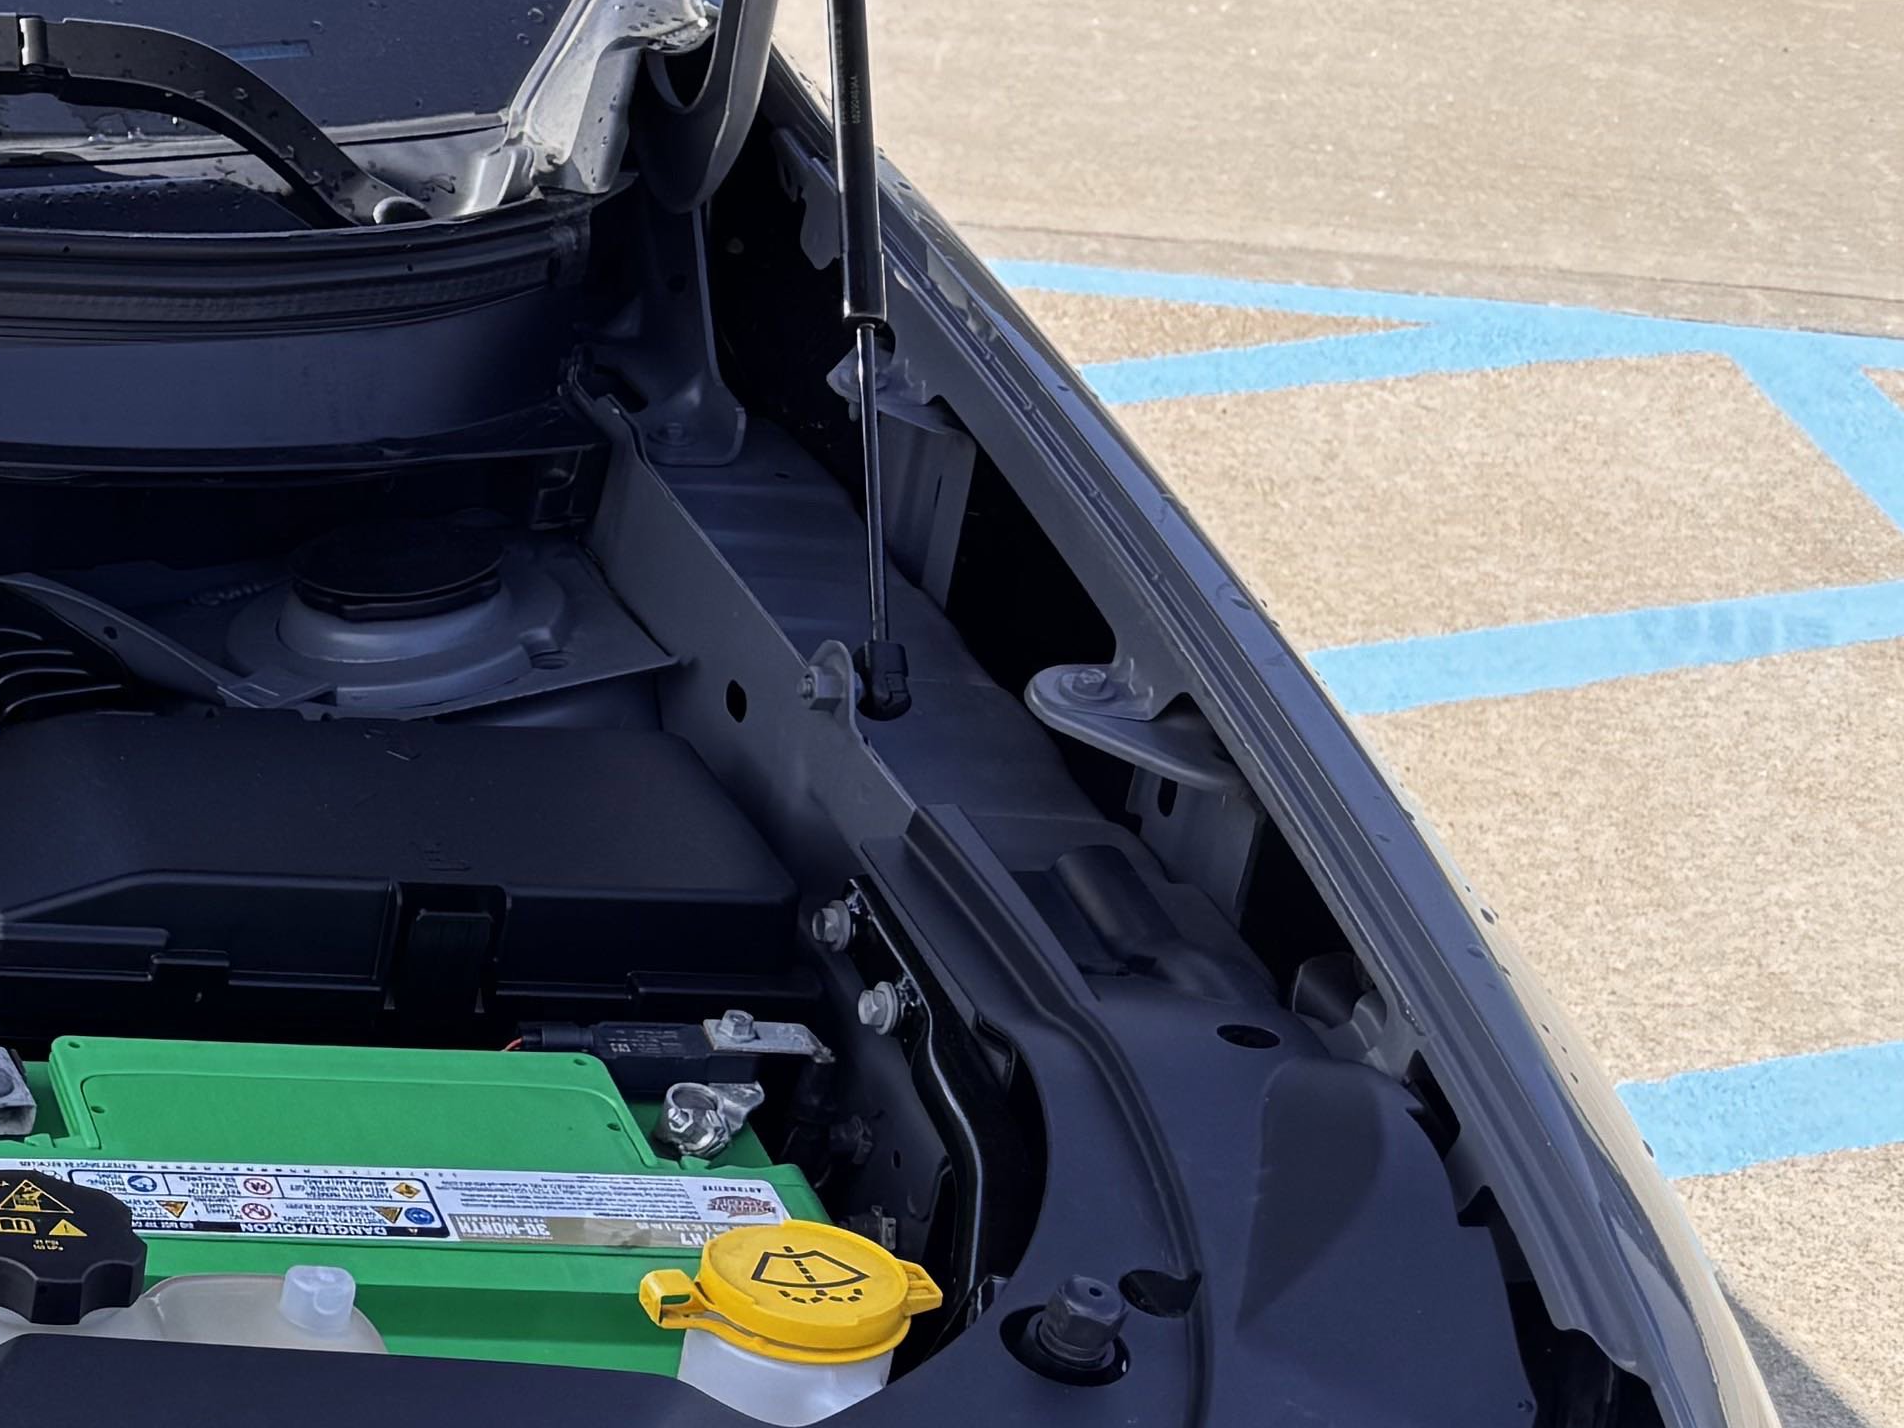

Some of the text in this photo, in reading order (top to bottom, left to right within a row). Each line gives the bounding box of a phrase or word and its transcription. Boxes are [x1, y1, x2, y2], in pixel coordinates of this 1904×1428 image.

[701, 1185, 762, 1193] AUTOMOTIVE
[240, 1223, 388, 1236] DANGER/POISON
[455, 1221, 550, 1238] 30-MONTH
